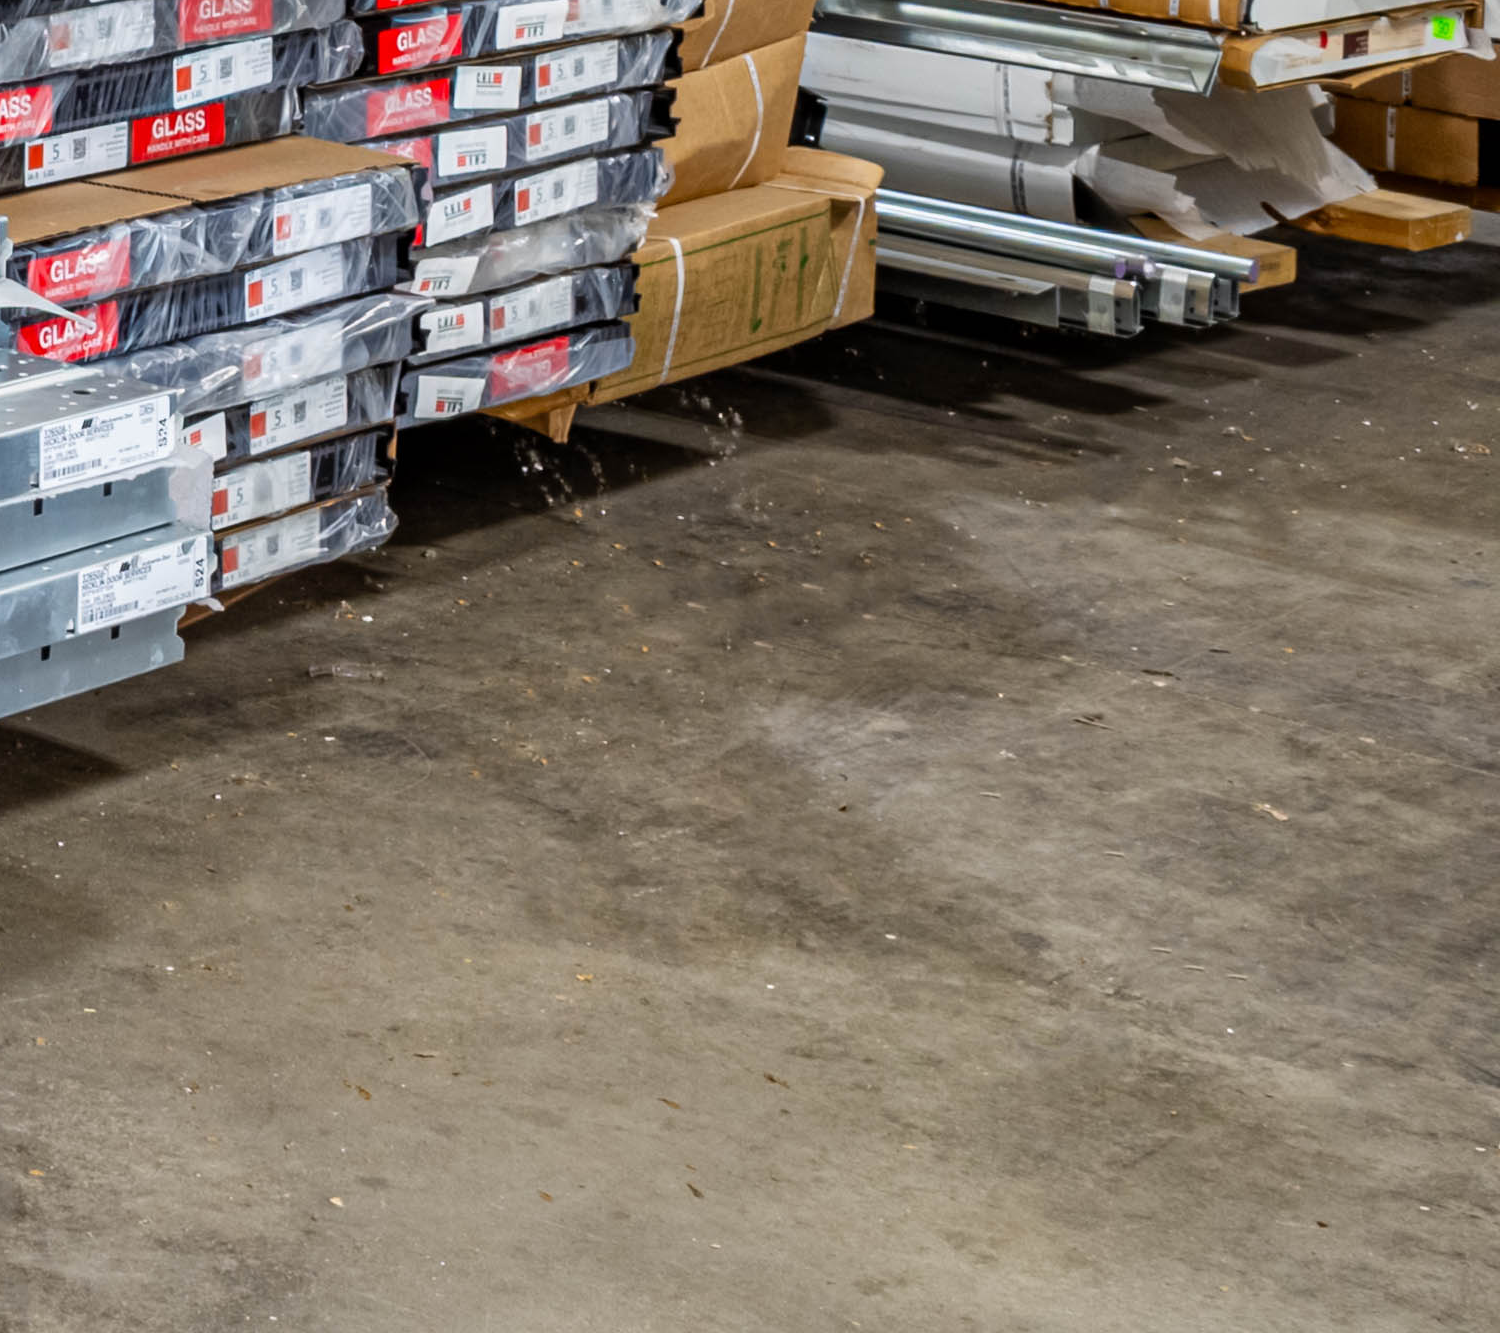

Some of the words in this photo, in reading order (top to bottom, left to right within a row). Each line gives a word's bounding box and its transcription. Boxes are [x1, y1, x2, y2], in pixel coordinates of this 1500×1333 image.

[385, 88, 433, 113] GLASS
[152, 111, 206, 139] GLASS
[147, 141, 174, 154] HANDLE
[174, 137, 192, 149] WITH
[192, 132, 210, 145] CARE
